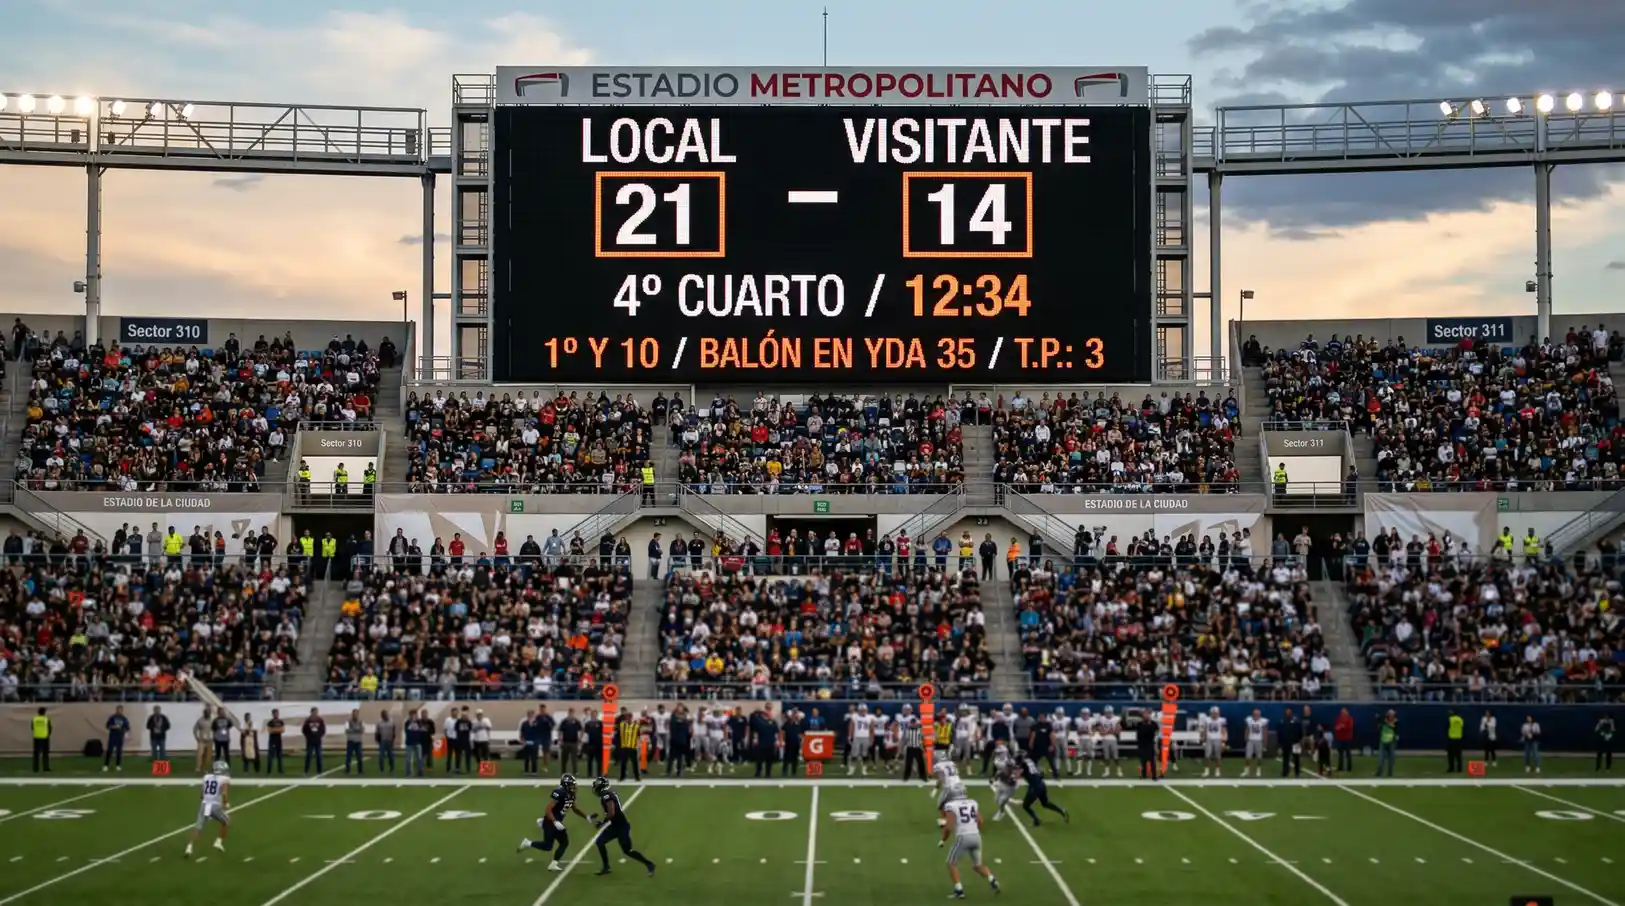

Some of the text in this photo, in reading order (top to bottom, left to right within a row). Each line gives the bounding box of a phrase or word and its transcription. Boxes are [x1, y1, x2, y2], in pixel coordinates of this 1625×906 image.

[592, 73, 1053, 98] ESTADIO METROPOLITANO
[582, 117, 737, 164] LOCAL
[842, 117, 1091, 164] VISITANTE
[615, 183, 690, 245] 21
[927, 183, 1012, 245] 14
[678, 273, 845, 317] CUARTO
[864, 273, 886, 318] /
[905, 274, 1032, 317] 12:34
[127, 324, 200, 338] Sector 310
[1434, 323, 1505, 338] Sector 311
[588, 337, 610, 369] Y
[620, 337, 660, 369] 10
[671, 336, 688, 369] /
[700, 328, 801, 369] BALÓN
[813, 337, 853, 369] EN
[863, 337, 927, 369] YDA
[936, 337, 976, 369] 35
[988, 336, 1004, 370] /
[1013, 337, 1073, 369] T.P.:
[1084, 337, 1105, 369] 3
[320, 438, 362, 448] Sector 310
[1283, 438, 1324, 448] Sector 311
[103, 497, 211, 508] ESTADIO DE LA CIUDAD
[1084, 499, 1188, 509] ESTADIO DE LA CIUDAD
[809, 737, 824, 754] G
[959, 806, 978, 824] 54
